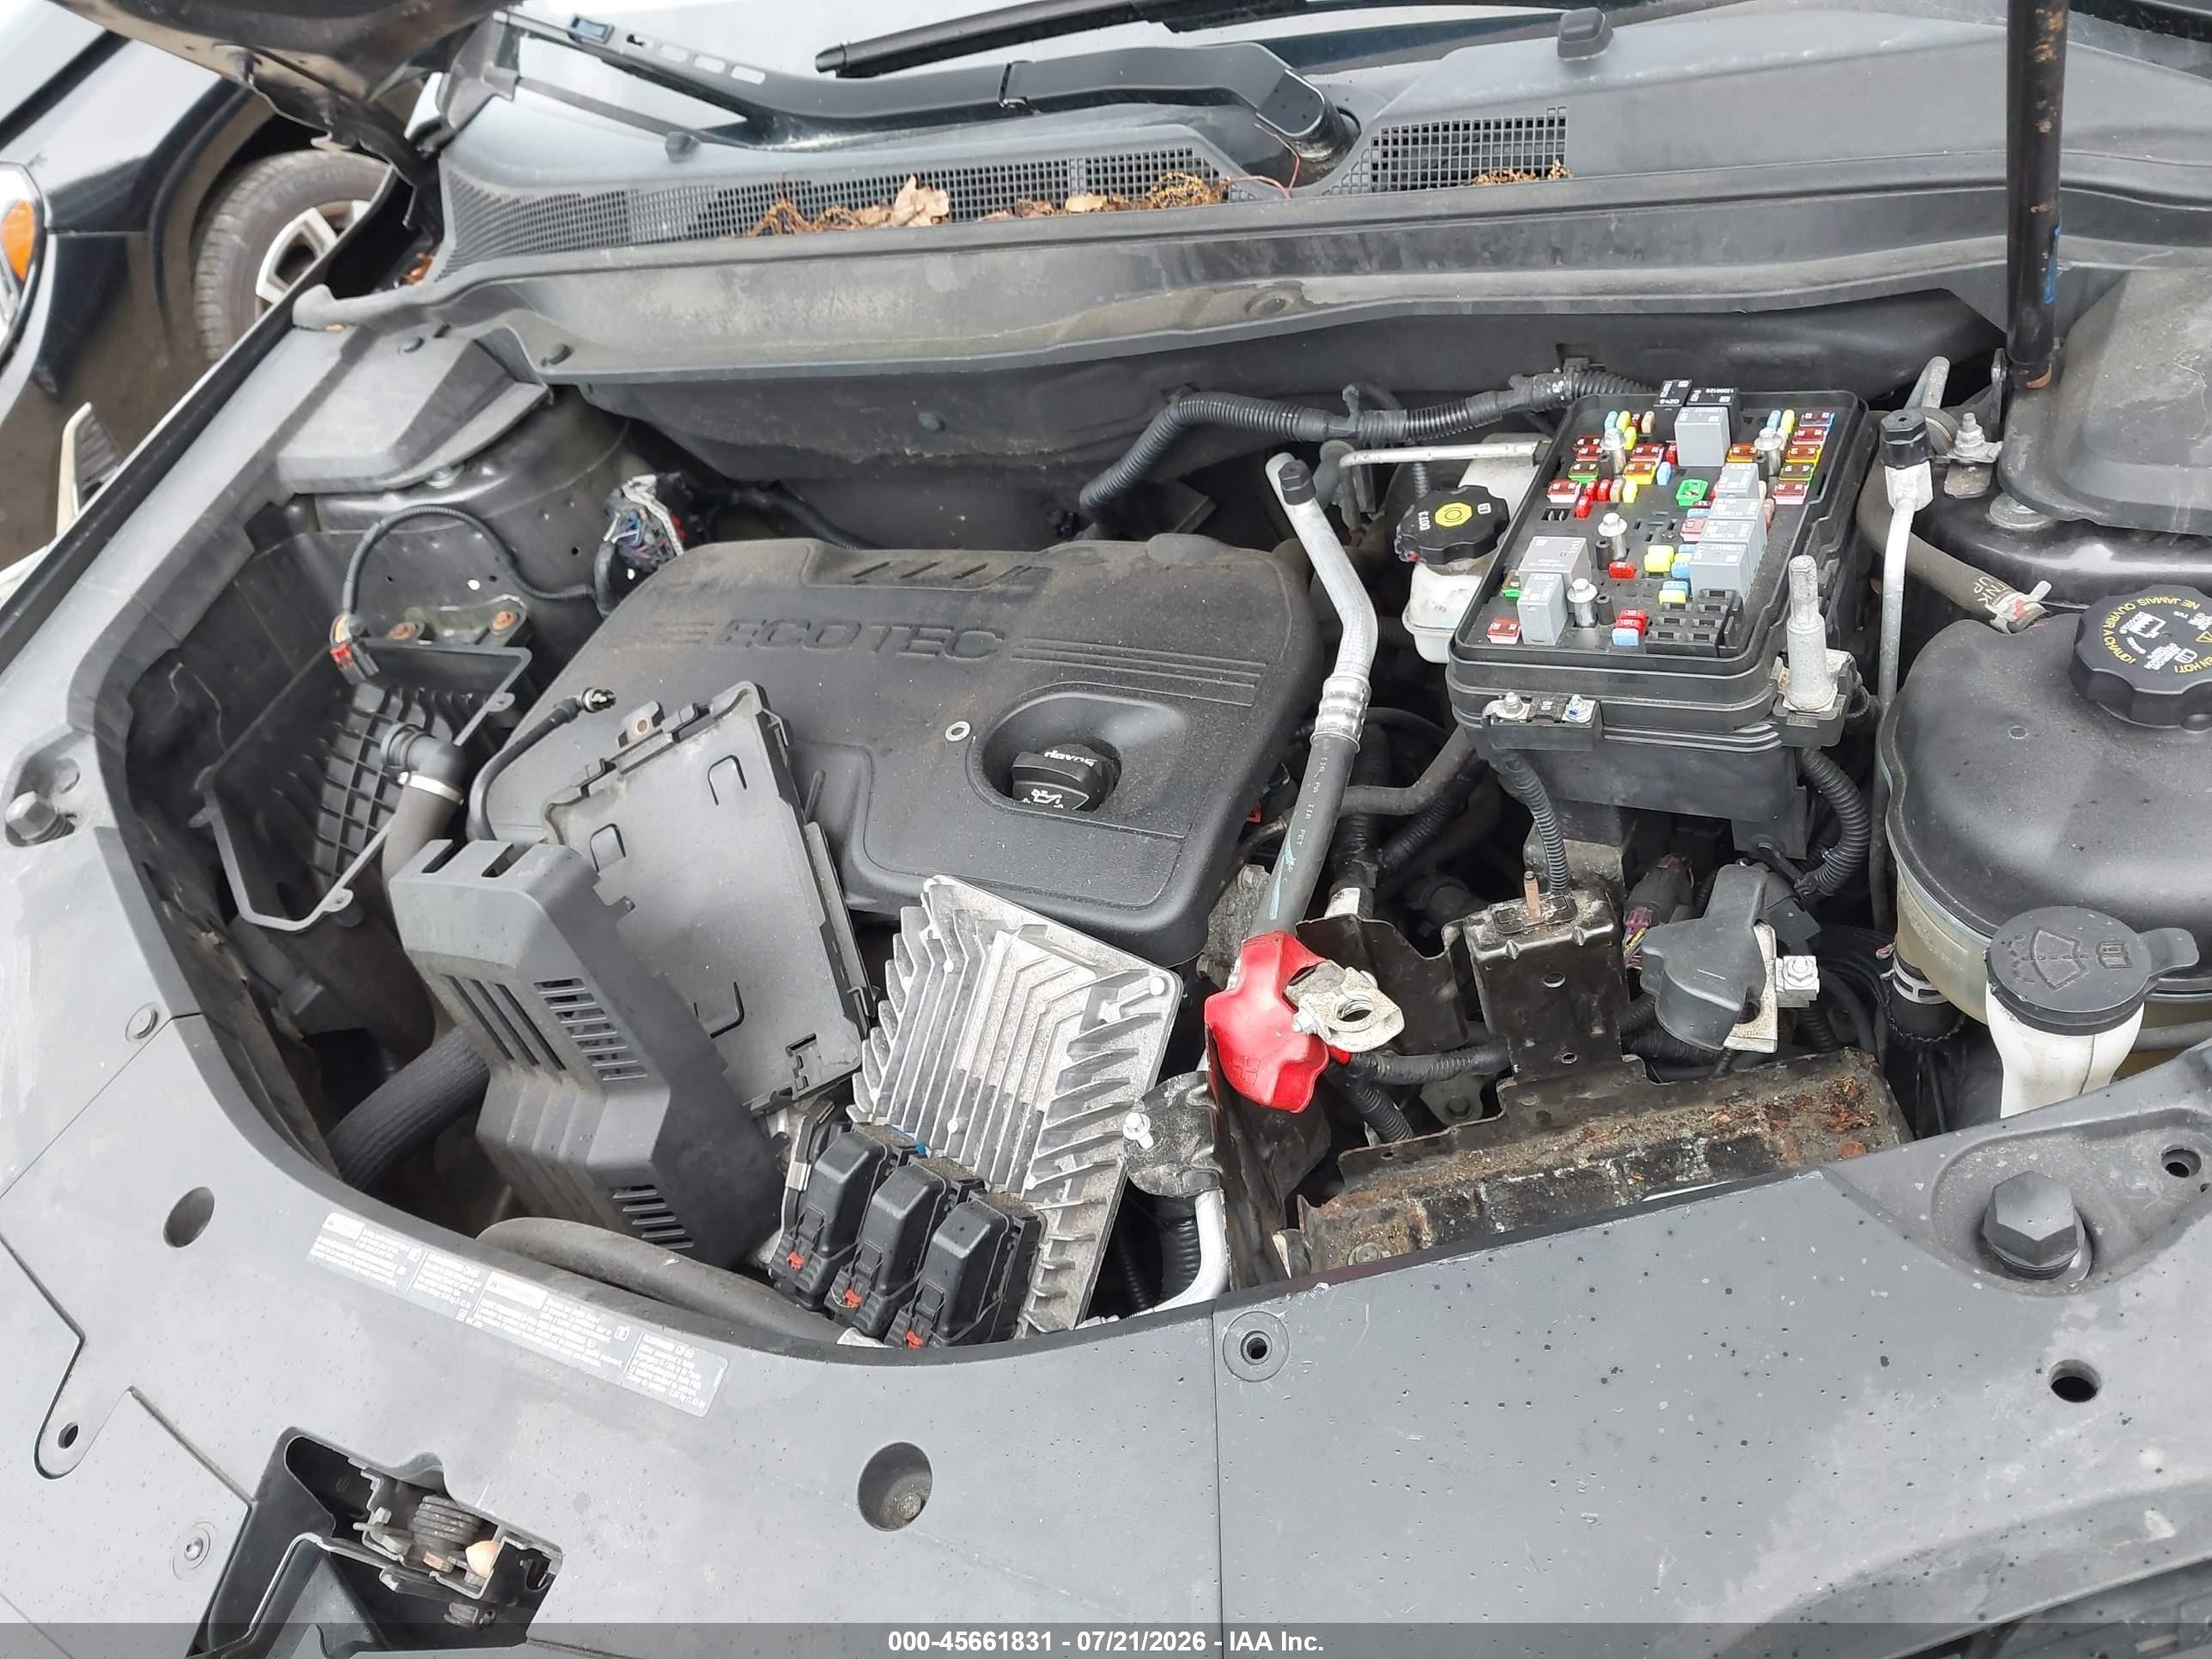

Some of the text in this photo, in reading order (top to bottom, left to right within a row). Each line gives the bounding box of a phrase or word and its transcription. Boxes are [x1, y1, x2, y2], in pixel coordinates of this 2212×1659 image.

[1973, 576, 1994, 594] UP
[2136, 596, 2182, 606] JAMAIS
[2181, 599, 2202, 611] NE
[2102, 603, 2136, 629] OUVRIR
[714, 618, 1006, 659] ECOTEC
[2173, 656, 2212, 673] EN HOT!
[1296, 829, 1306, 847] PET
